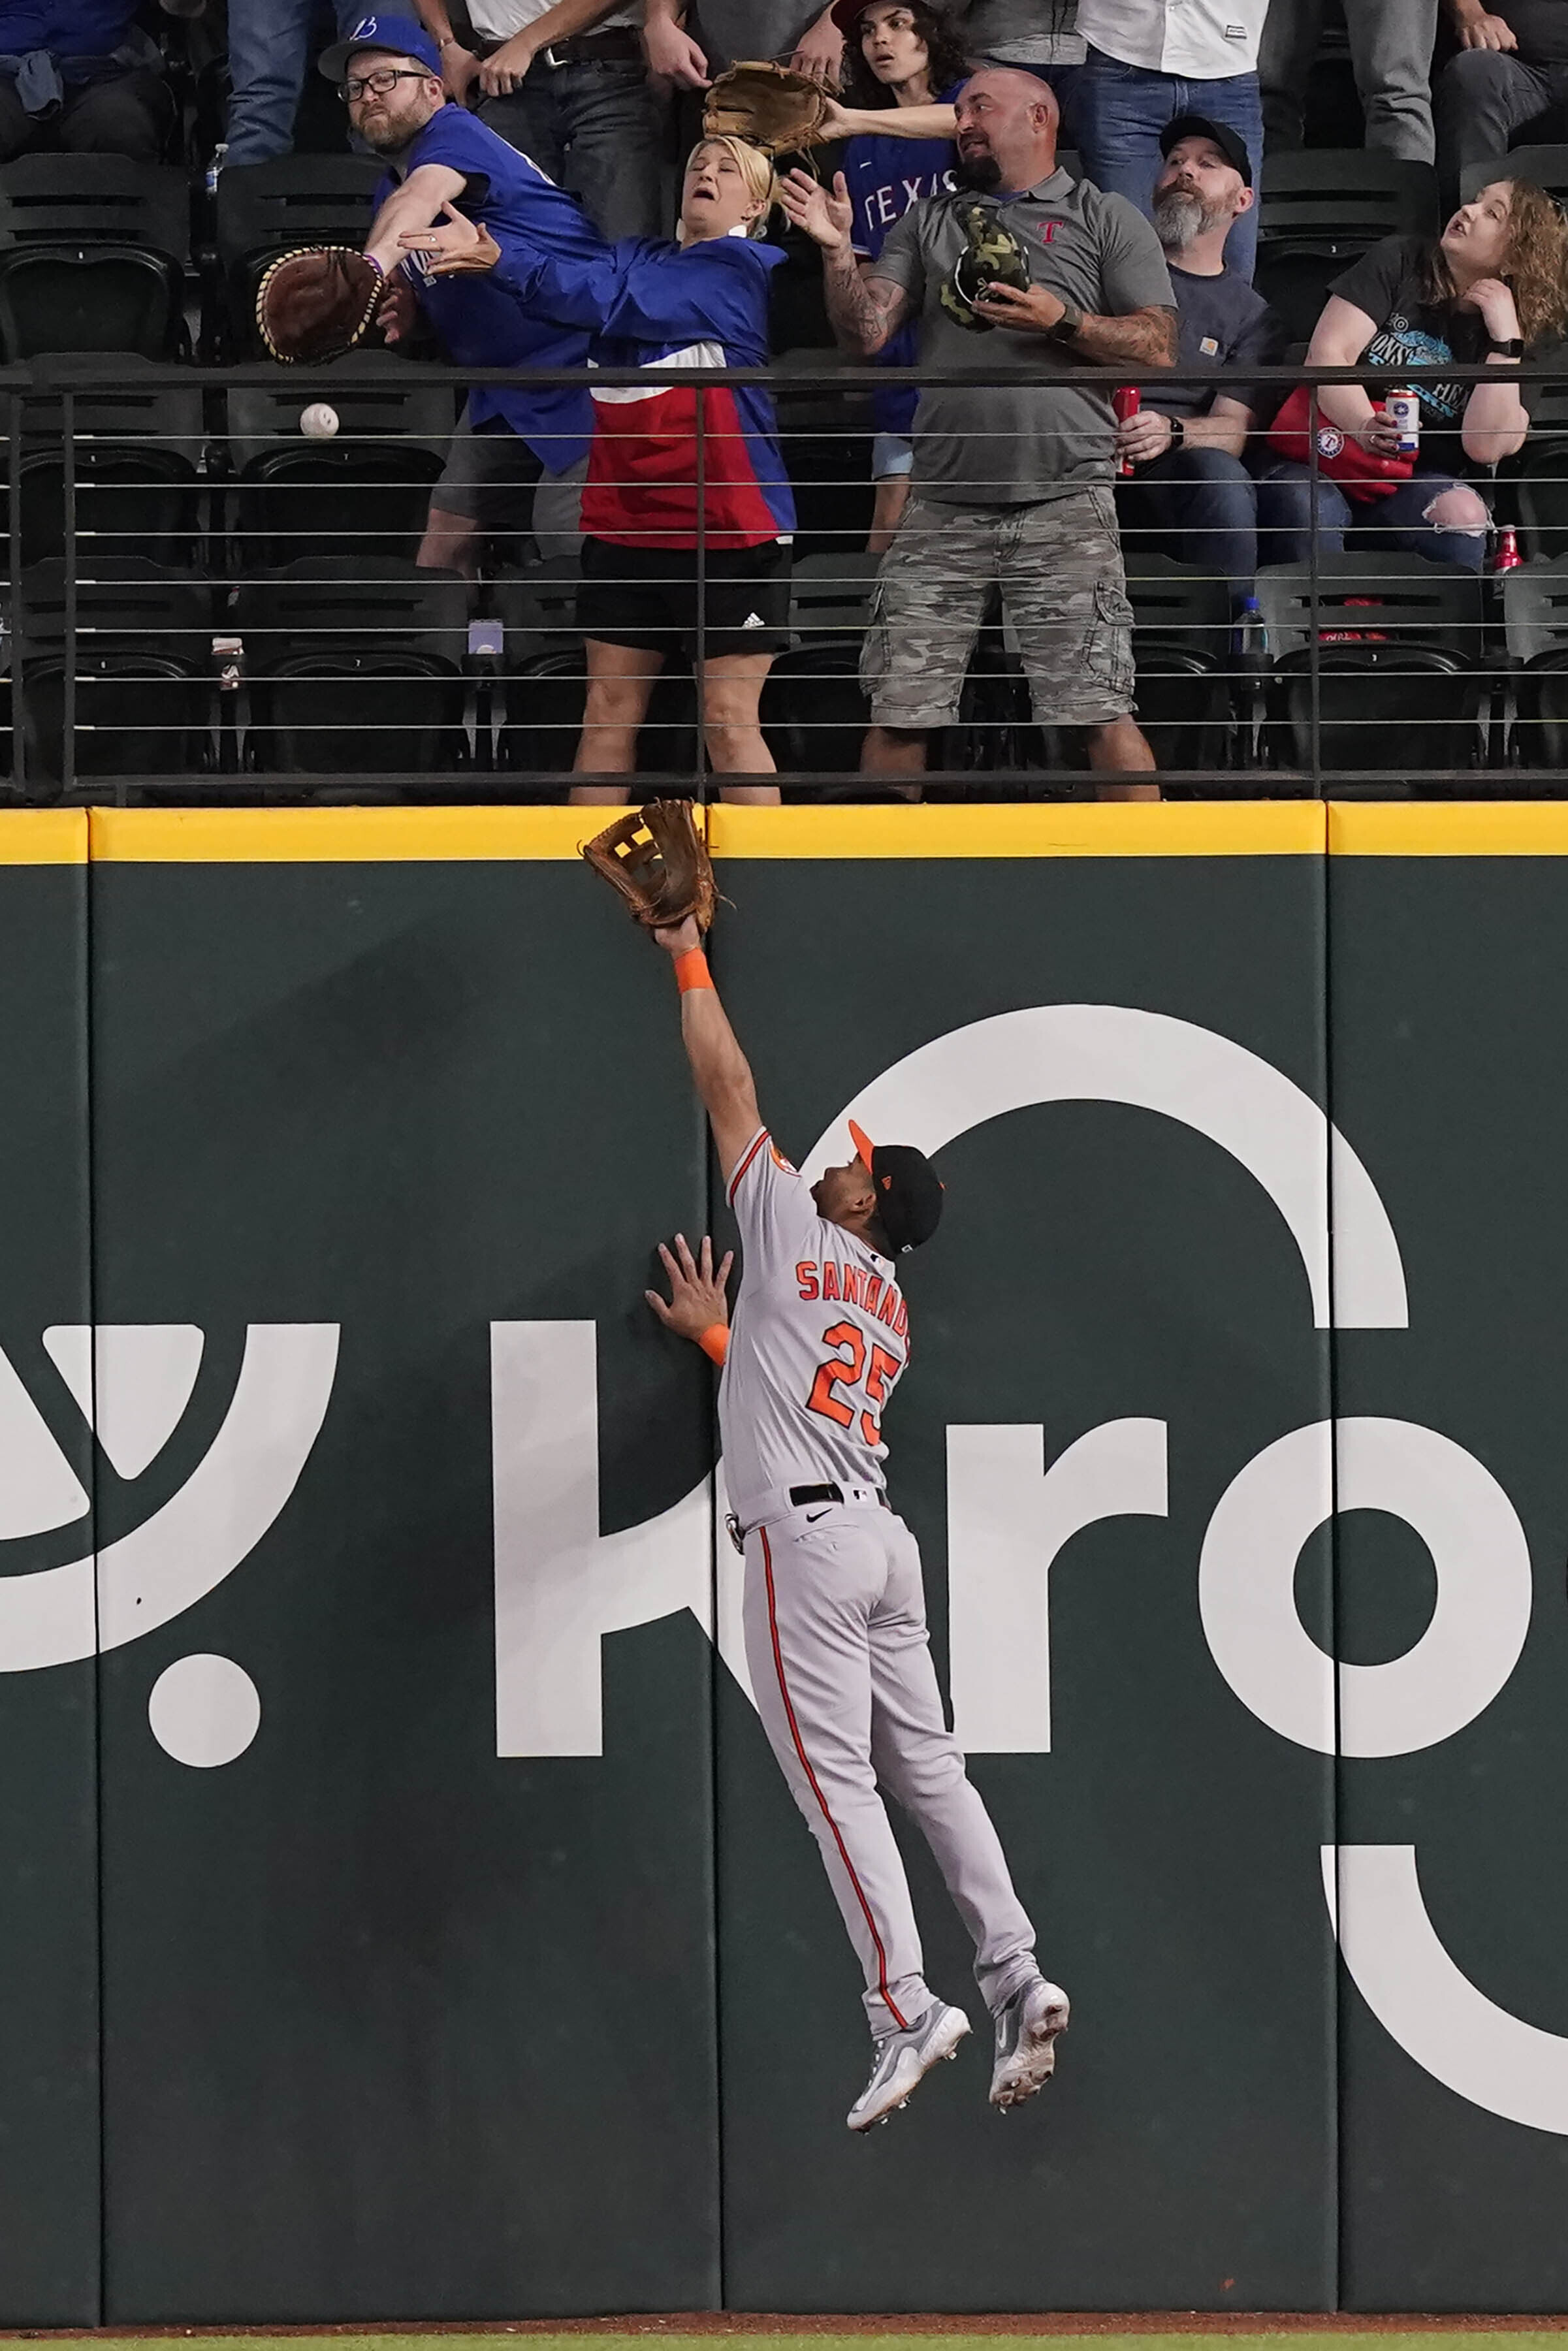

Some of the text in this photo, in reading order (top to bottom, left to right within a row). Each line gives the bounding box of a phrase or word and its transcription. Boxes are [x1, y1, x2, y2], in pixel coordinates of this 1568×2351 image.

[864, 169, 958, 231] TEXAS
[1037, 220, 1064, 244] T
[795, 1261, 911, 1368] SANTAND
[805, 1320, 902, 1447] 25
